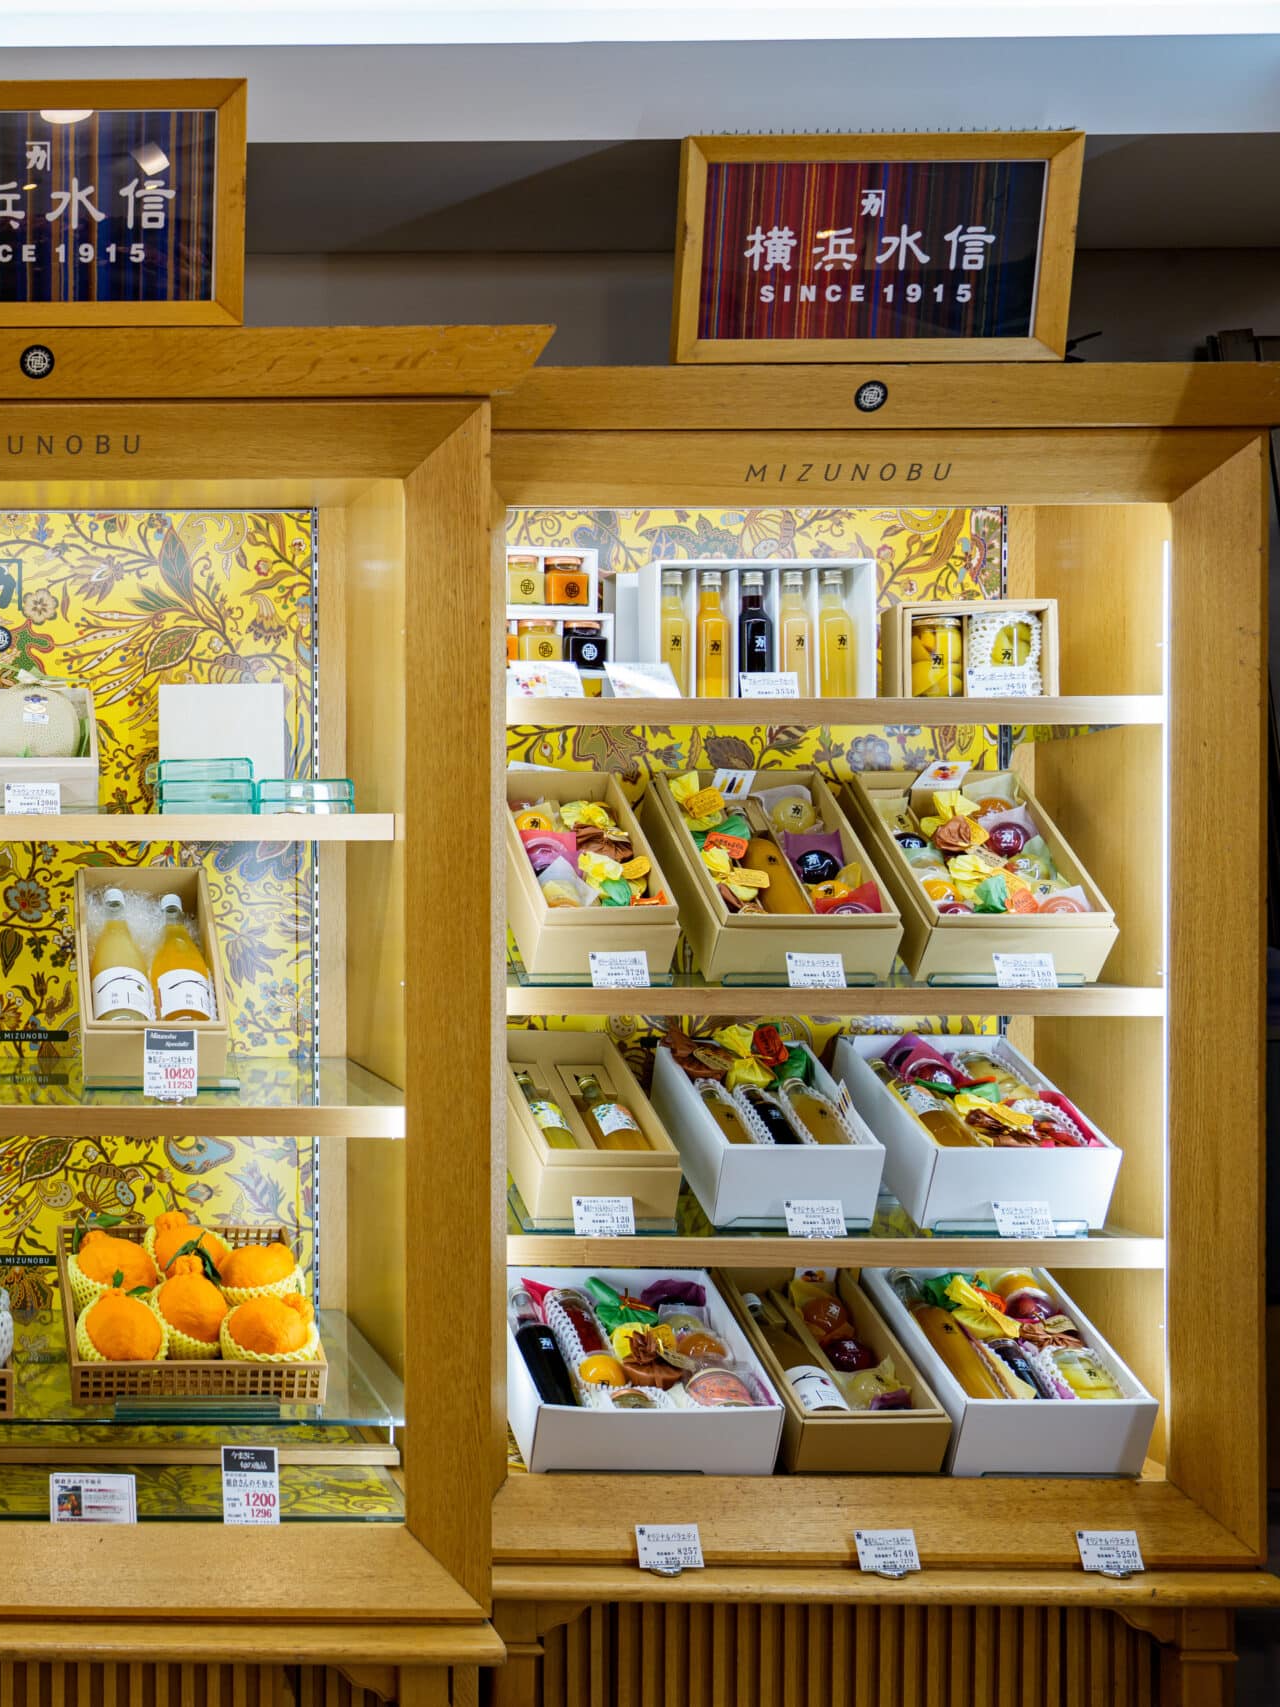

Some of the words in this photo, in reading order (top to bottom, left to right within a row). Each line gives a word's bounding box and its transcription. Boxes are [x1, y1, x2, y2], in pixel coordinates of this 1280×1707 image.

[55, 243, 146, 263] 1915
[743, 223, 996, 272] 横浜水信
[760, 284, 865, 302] SINCE
[883, 283, 973, 303] 1915
[744, 463, 953, 482] MIZUNOBU
[4, 1032, 49, 1040] MIZUNOBU
[164, 1068, 195, 1080] 10420
[245, 1492, 276, 1508] 1200
[250, 1508, 272, 1519] 1296
[893, 1550, 914, 1558] 6740
[1116, 1550, 1137, 1559] 5250
